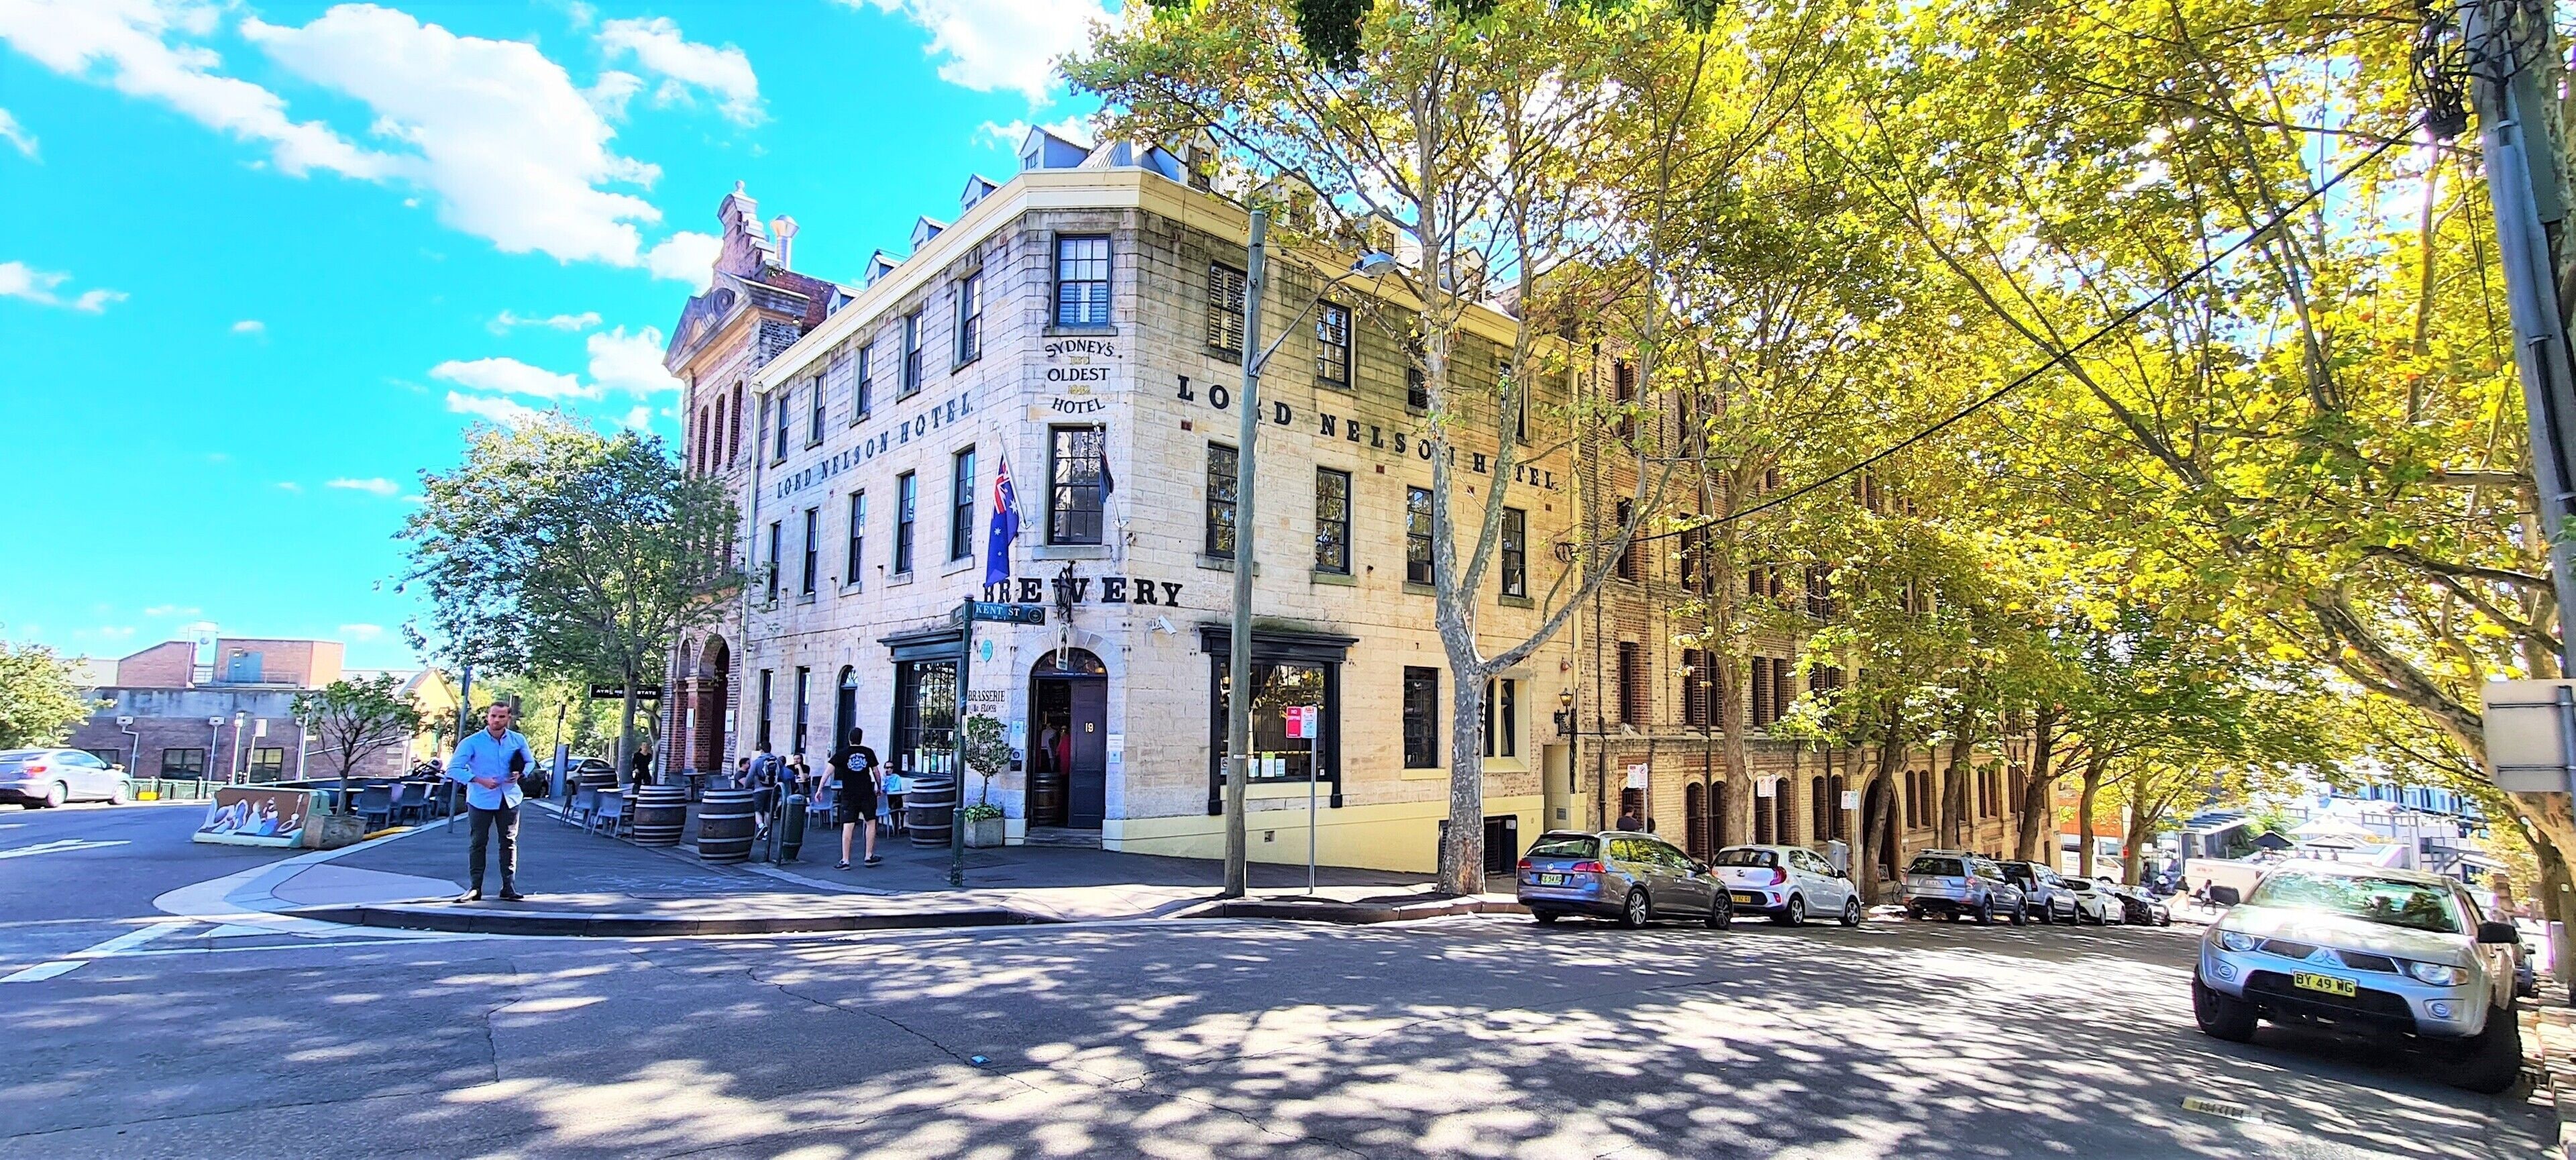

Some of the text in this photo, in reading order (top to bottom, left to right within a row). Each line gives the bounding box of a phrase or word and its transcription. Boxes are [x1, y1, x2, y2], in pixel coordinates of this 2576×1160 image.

[1044, 339, 1114, 358] SYDNEY'S
[1047, 368, 1110, 382] OLDEST
[1051, 397, 1106, 413] HOTEL
[1177, 374, 1291, 425] LOD
[777, 468, 812, 499] LORD
[821, 431, 889, 480] NELSON
[975, 604, 1020, 616] KENT ST
[968, 690, 1005, 702] BRASSERIE
[1085, 723, 1094, 733] 19
[2296, 973, 2353, 993] BY 49 WG
